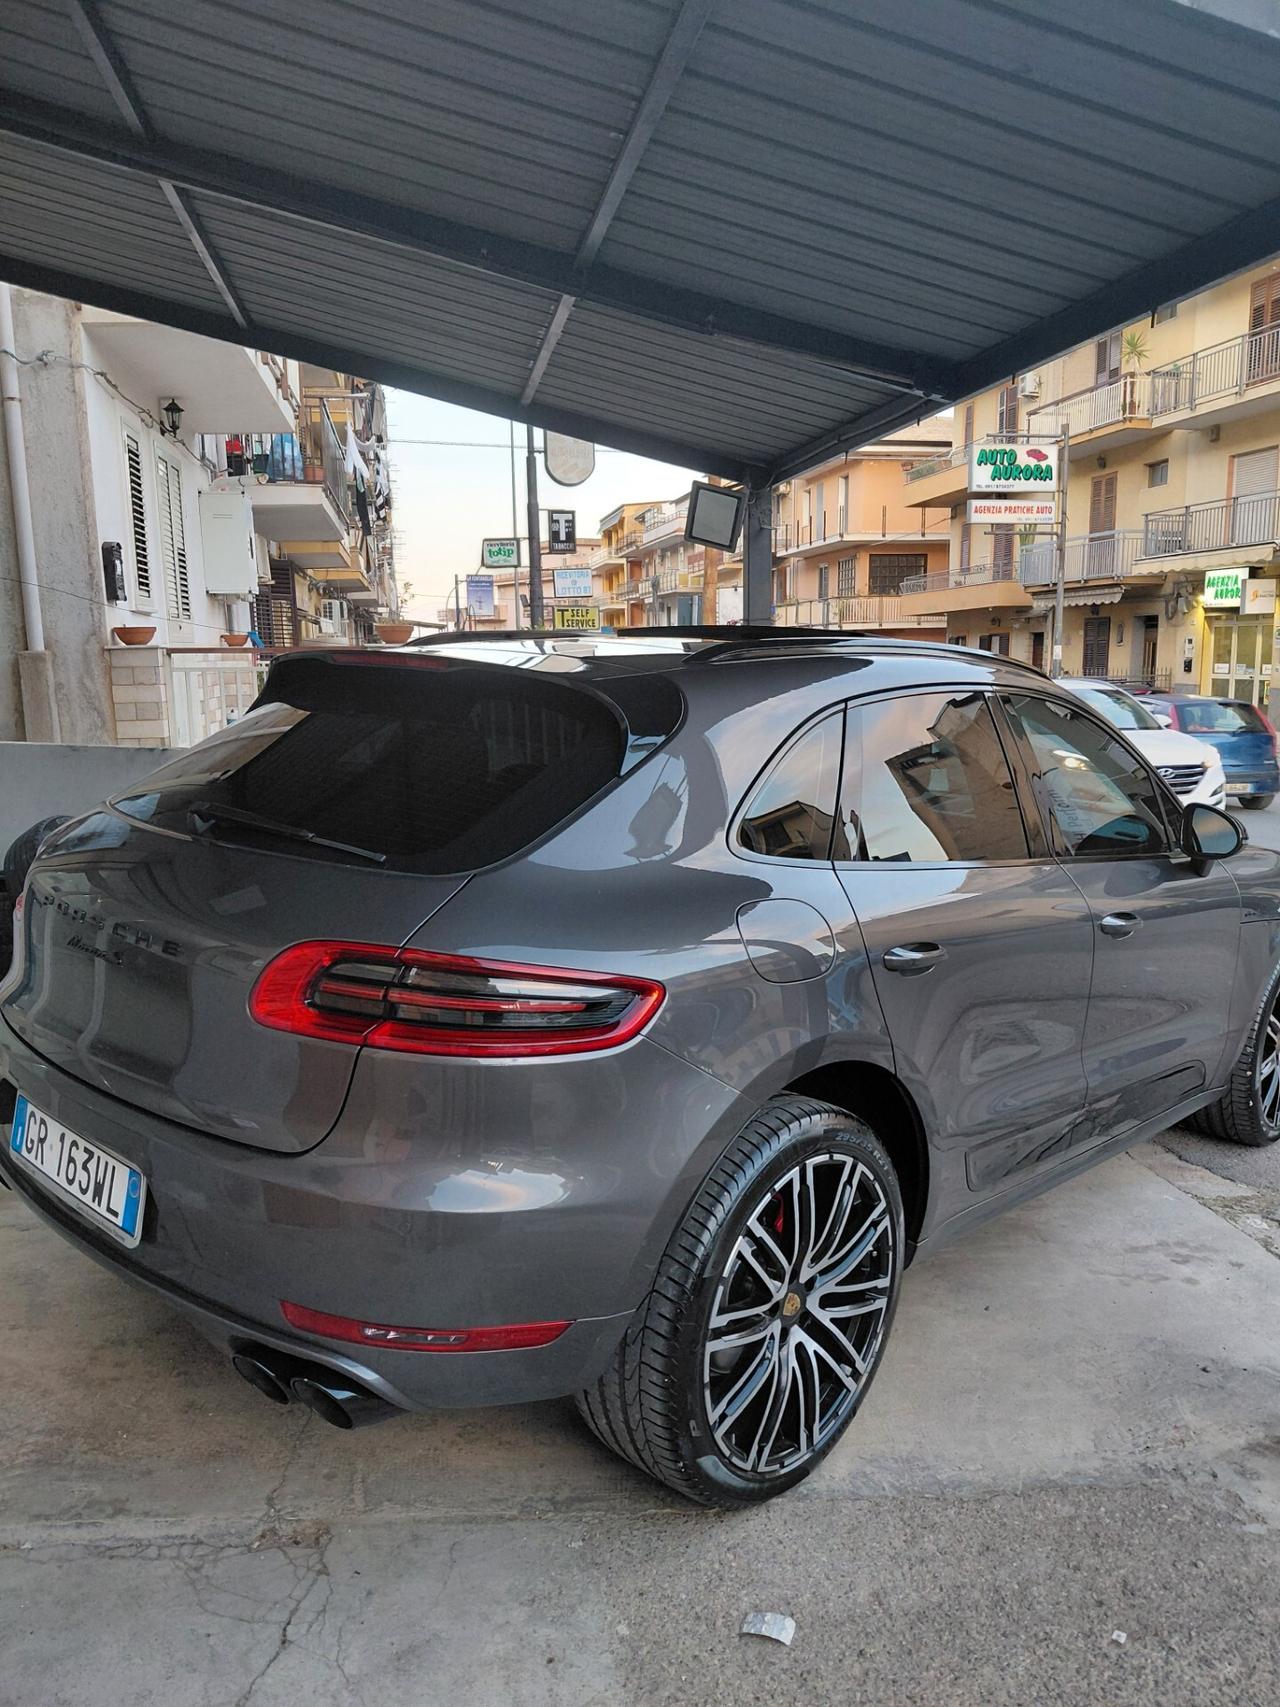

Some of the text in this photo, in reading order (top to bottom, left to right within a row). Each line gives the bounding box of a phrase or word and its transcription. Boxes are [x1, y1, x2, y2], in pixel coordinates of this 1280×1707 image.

[977, 448, 1018, 466] AUTO
[990, 463, 1054, 482] AURORA
[974, 505, 1053, 515] AGENZIA PRATICHE AUTO
[553, 513, 573, 541] T
[488, 547, 515, 559] totip
[552, 543, 576, 551] TABACCHI
[1206, 574, 1239, 588] AGENZIA
[1214, 587, 1241, 601] AUROR
[556, 608, 569, 628] T
[571, 608, 590, 618] SELF
[566, 618, 596, 628] SERVICE
[25, 1110, 120, 1219] GR 163WL
